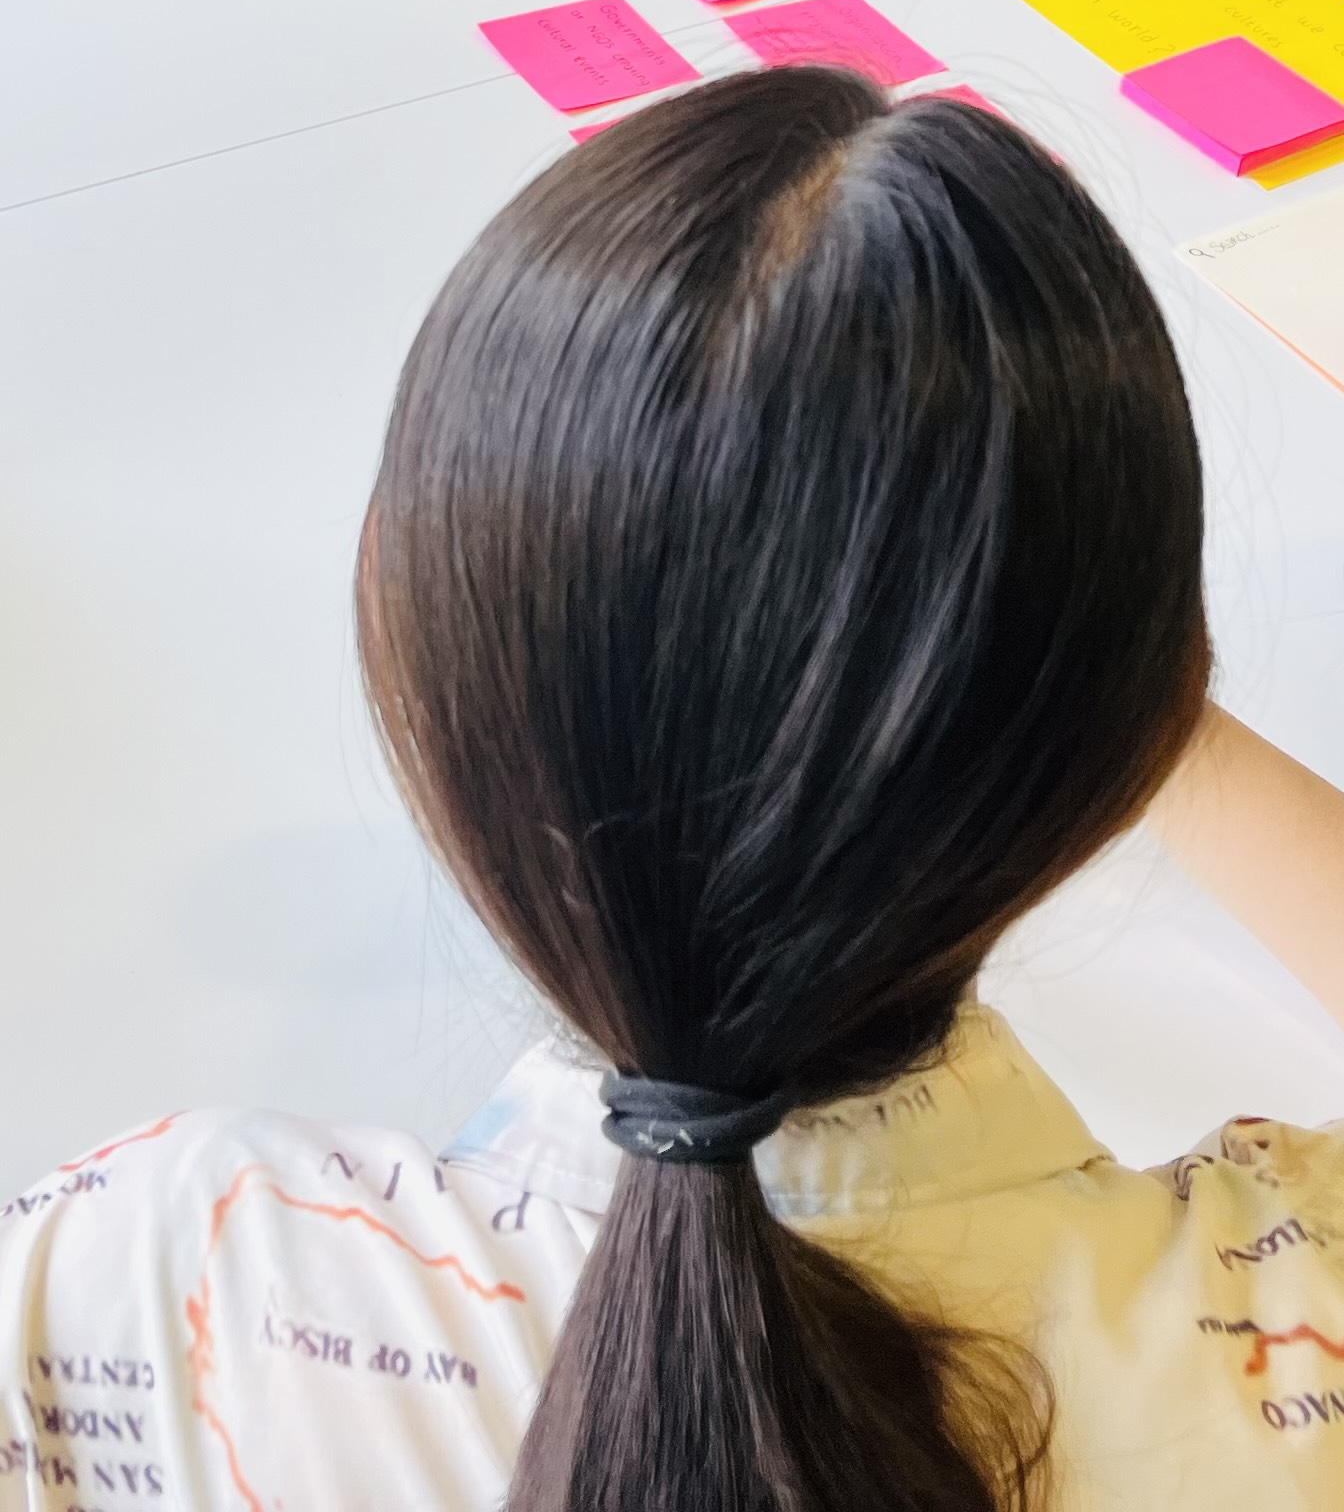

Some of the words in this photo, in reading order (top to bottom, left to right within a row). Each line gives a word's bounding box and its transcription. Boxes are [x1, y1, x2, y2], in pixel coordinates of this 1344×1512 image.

[599, 3, 668, 68] Governments
[1222, 5, 1287, 51] cultures
[1296, 13, 1325, 36] we
[573, 55, 611, 87] events
[611, 52, 652, 88] creating
[366, 1341, 413, 1379] OF
[92, 1459, 165, 1497] SAN
